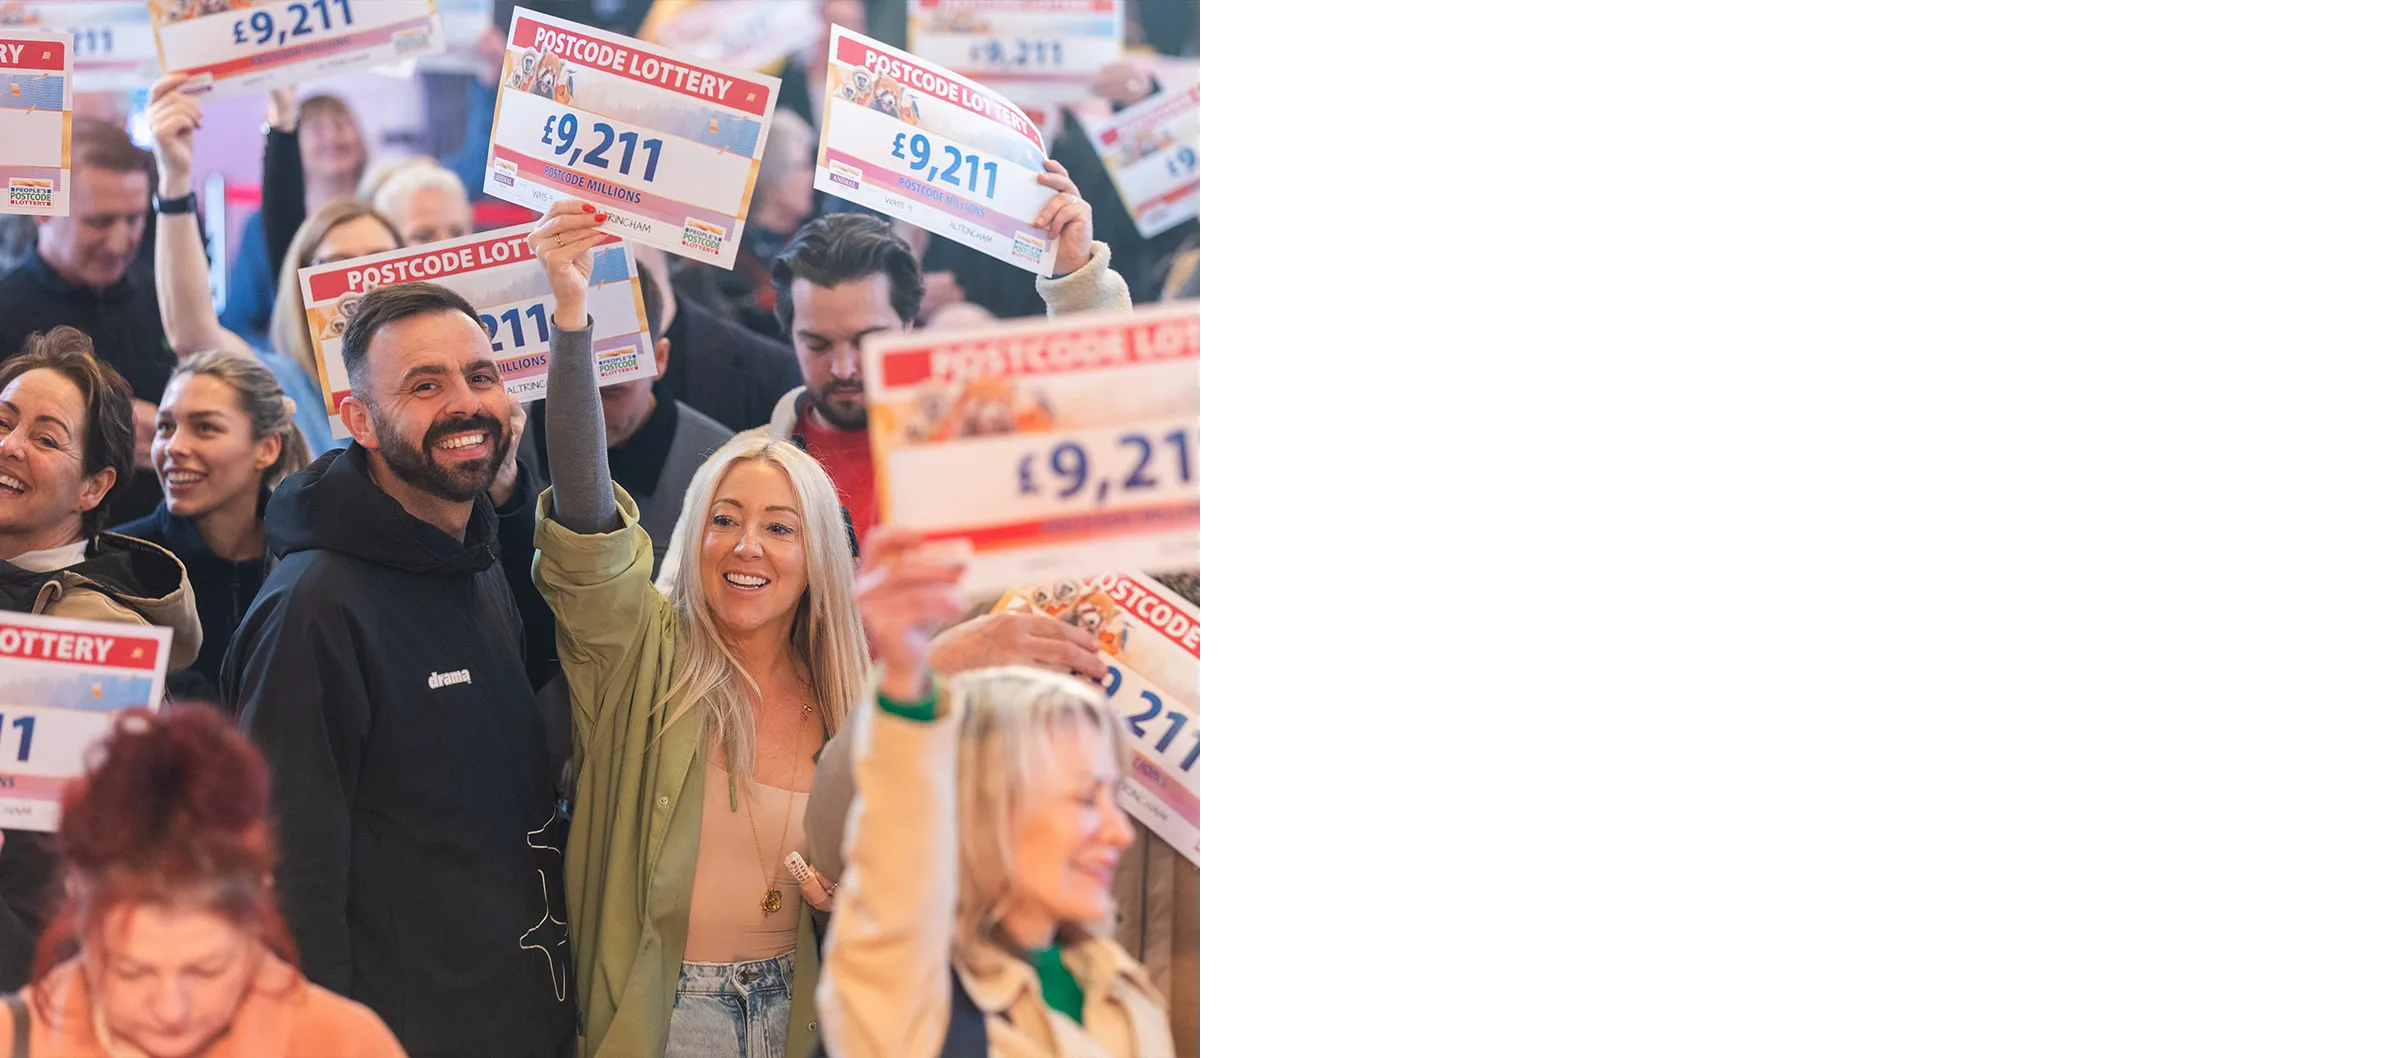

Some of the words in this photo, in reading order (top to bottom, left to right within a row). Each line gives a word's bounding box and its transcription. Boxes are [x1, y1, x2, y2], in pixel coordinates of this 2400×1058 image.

[233, 0, 353, 45] £9,211
[534, 27, 627, 72] POSTCODE
[629, 53, 734, 101] LOTTERY
[865, 50, 960, 102] POSTCODE
[962, 88, 1030, 135] LOTTERY
[541, 112, 664, 183] £9,211
[891, 132, 998, 199] £9,211
[544, 165, 585, 187] POSTCODE
[586, 179, 642, 204] MILLIONS
[832, 175, 857, 187] ANIMAL
[10, 192, 51, 201] POSTCODE
[899, 177, 944, 202] POSTCODE
[945, 195, 985, 218] MILLIONS
[682, 232, 721, 250] POSTCODE
[689, 228, 718, 240] PEOPLE'S
[685, 241, 714, 254] LOTTERY
[347, 248, 475, 291] POSTCODE
[478, 237, 536, 265] LOTT
[599, 359, 638, 372] POSTCODE
[602, 355, 632, 365] PEOPLE'S
[605, 366, 634, 377] LOTTERY
[506, 379, 547, 395] ALTRINC
[428, 668, 471, 690] drama
